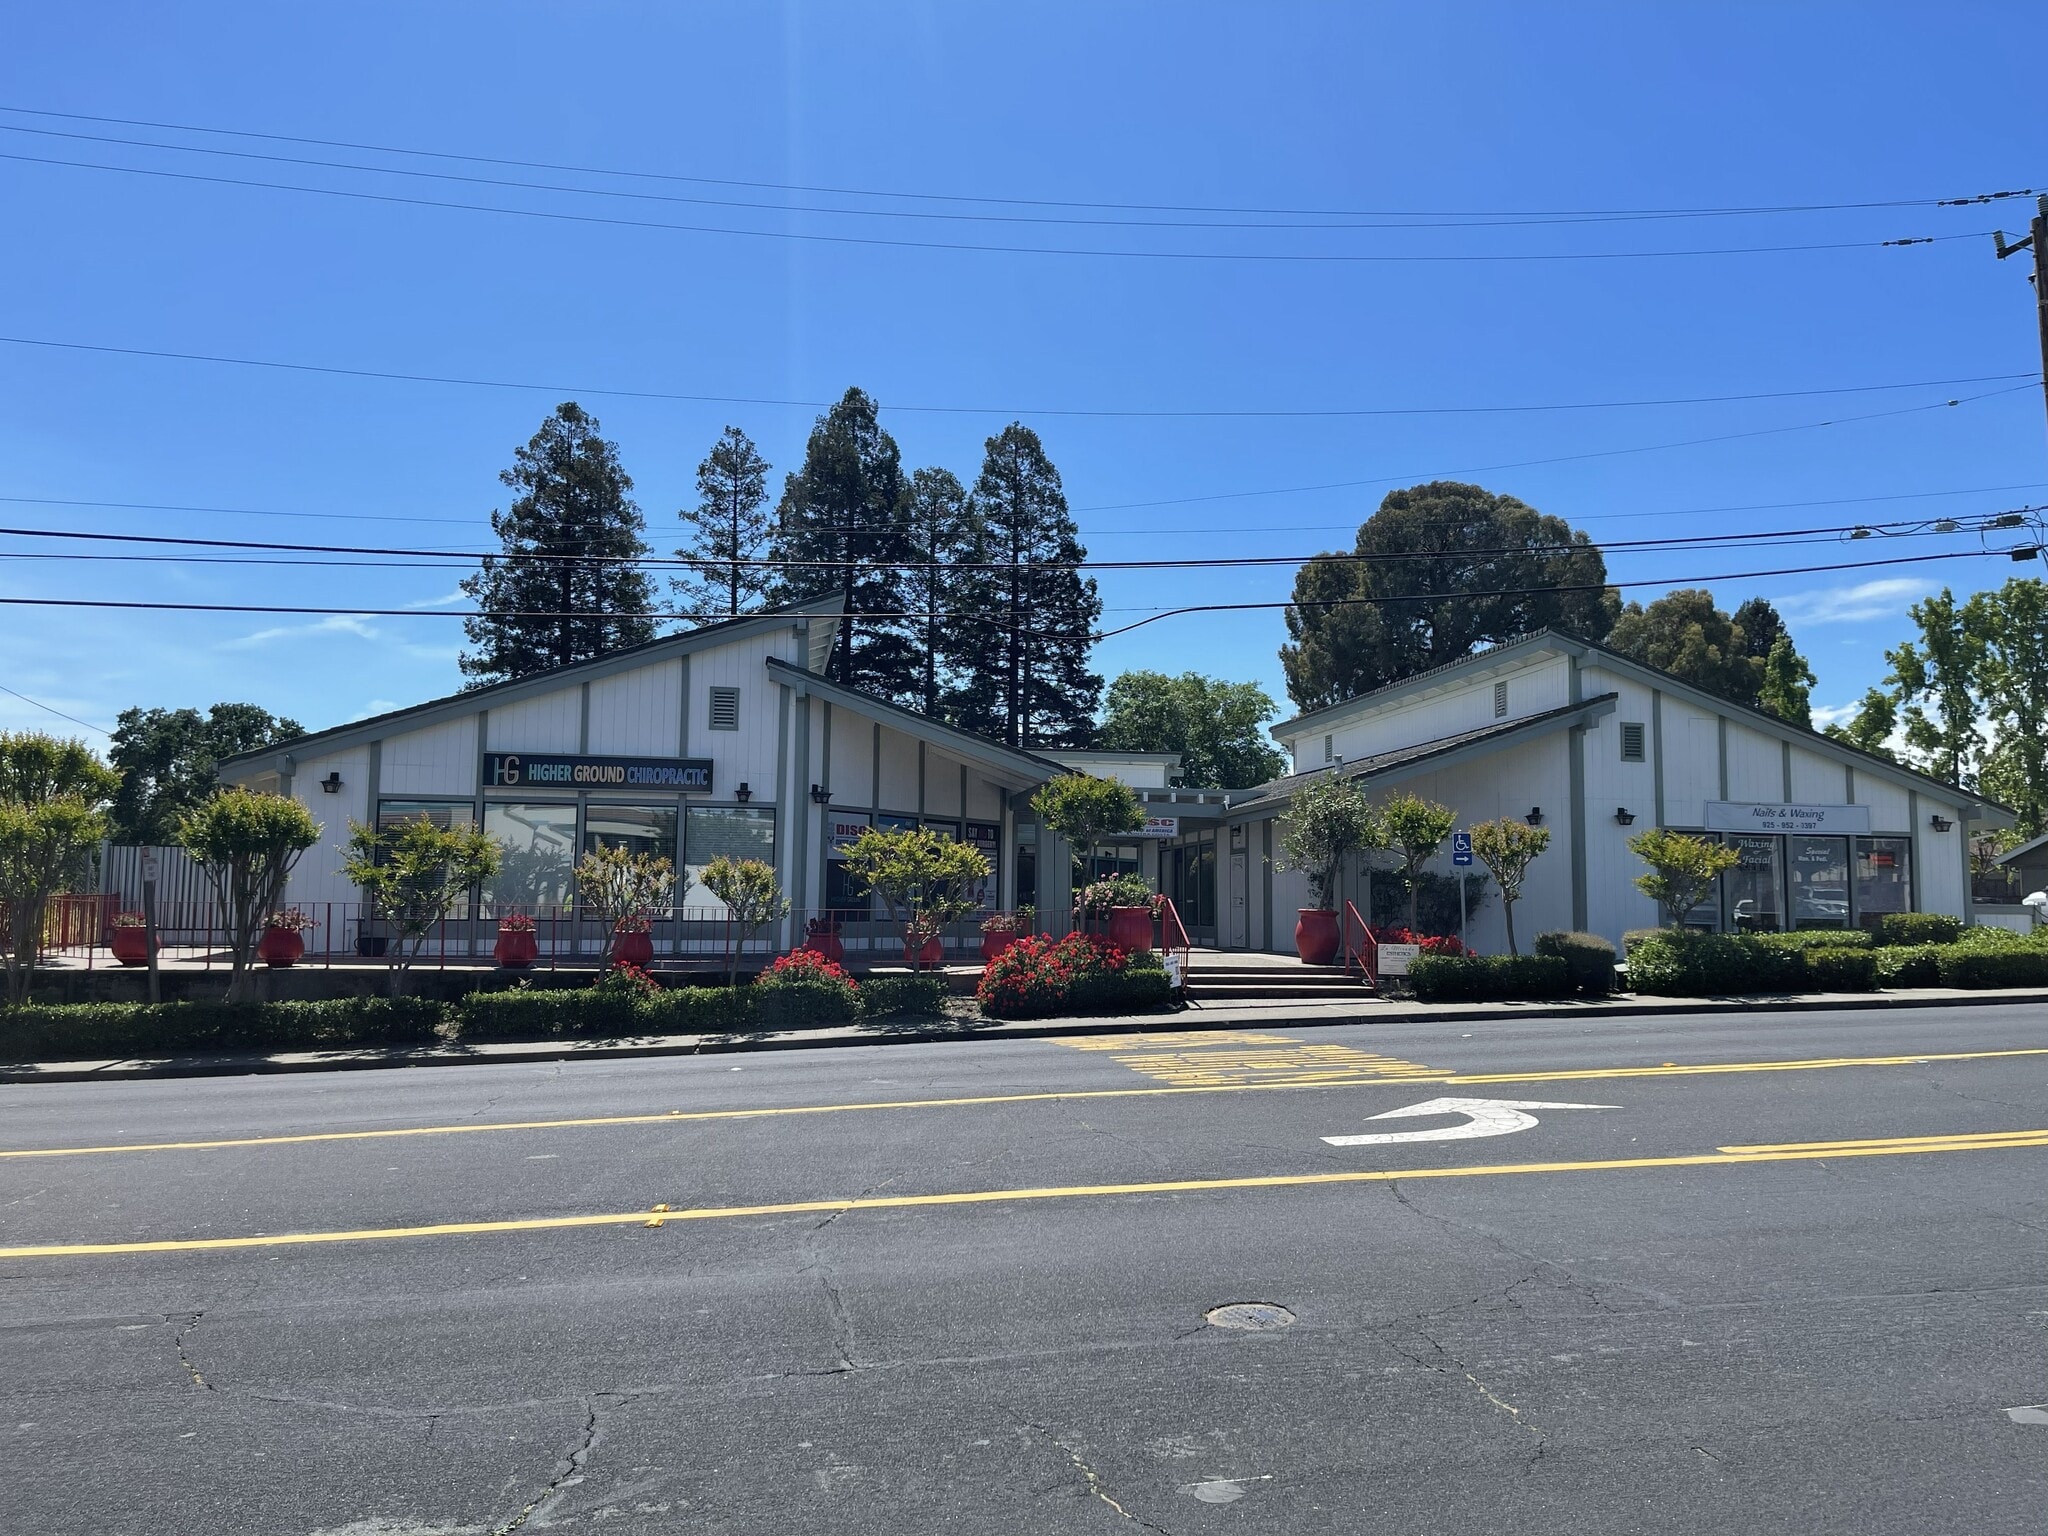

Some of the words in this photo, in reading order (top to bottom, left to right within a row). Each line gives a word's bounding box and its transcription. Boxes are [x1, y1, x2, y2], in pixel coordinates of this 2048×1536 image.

[528, 763, 572, 782] HIGHER
[574, 764, 625, 783] GROUND
[627, 766, 708, 786] CHIROPRACTIC
[1778, 808, 1786, 818] &
[1790, 808, 1825, 821] Waxing
[1738, 838, 1775, 851] Waxing
[1742, 854, 1774, 866] Facial
